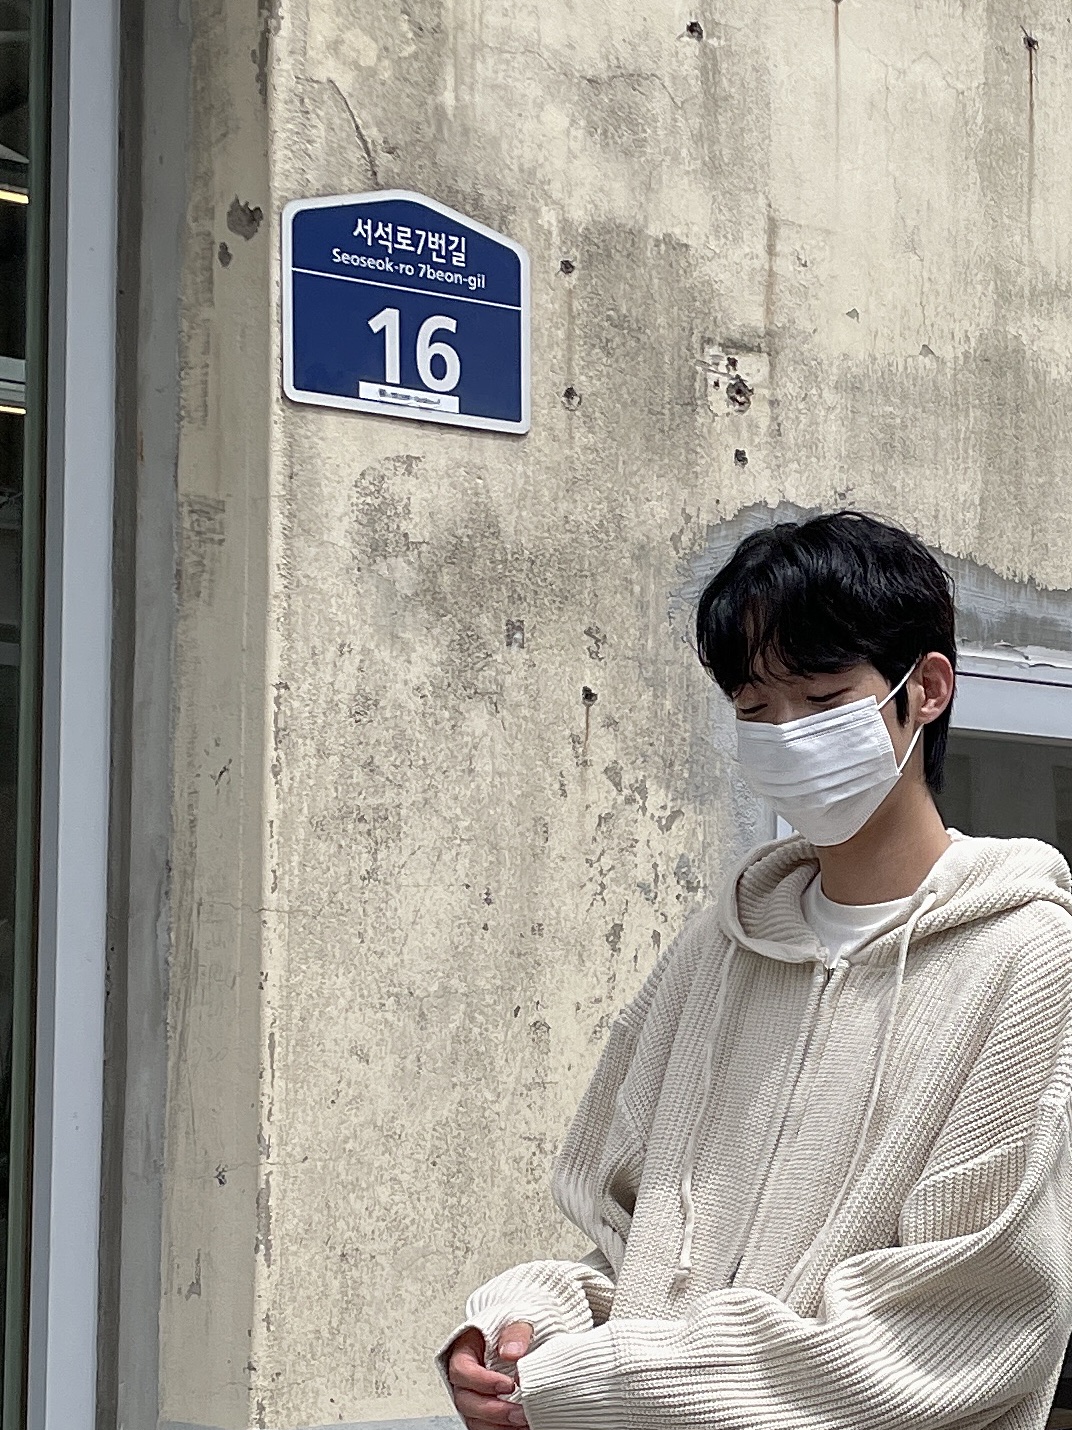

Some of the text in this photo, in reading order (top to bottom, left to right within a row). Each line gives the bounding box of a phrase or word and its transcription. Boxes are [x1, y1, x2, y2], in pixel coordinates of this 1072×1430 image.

[353, 218, 467, 268] 서석로7번길
[332, 248, 486, 291] Seoseok-ro 7beon-gil
[367, 307, 461, 393] 16
